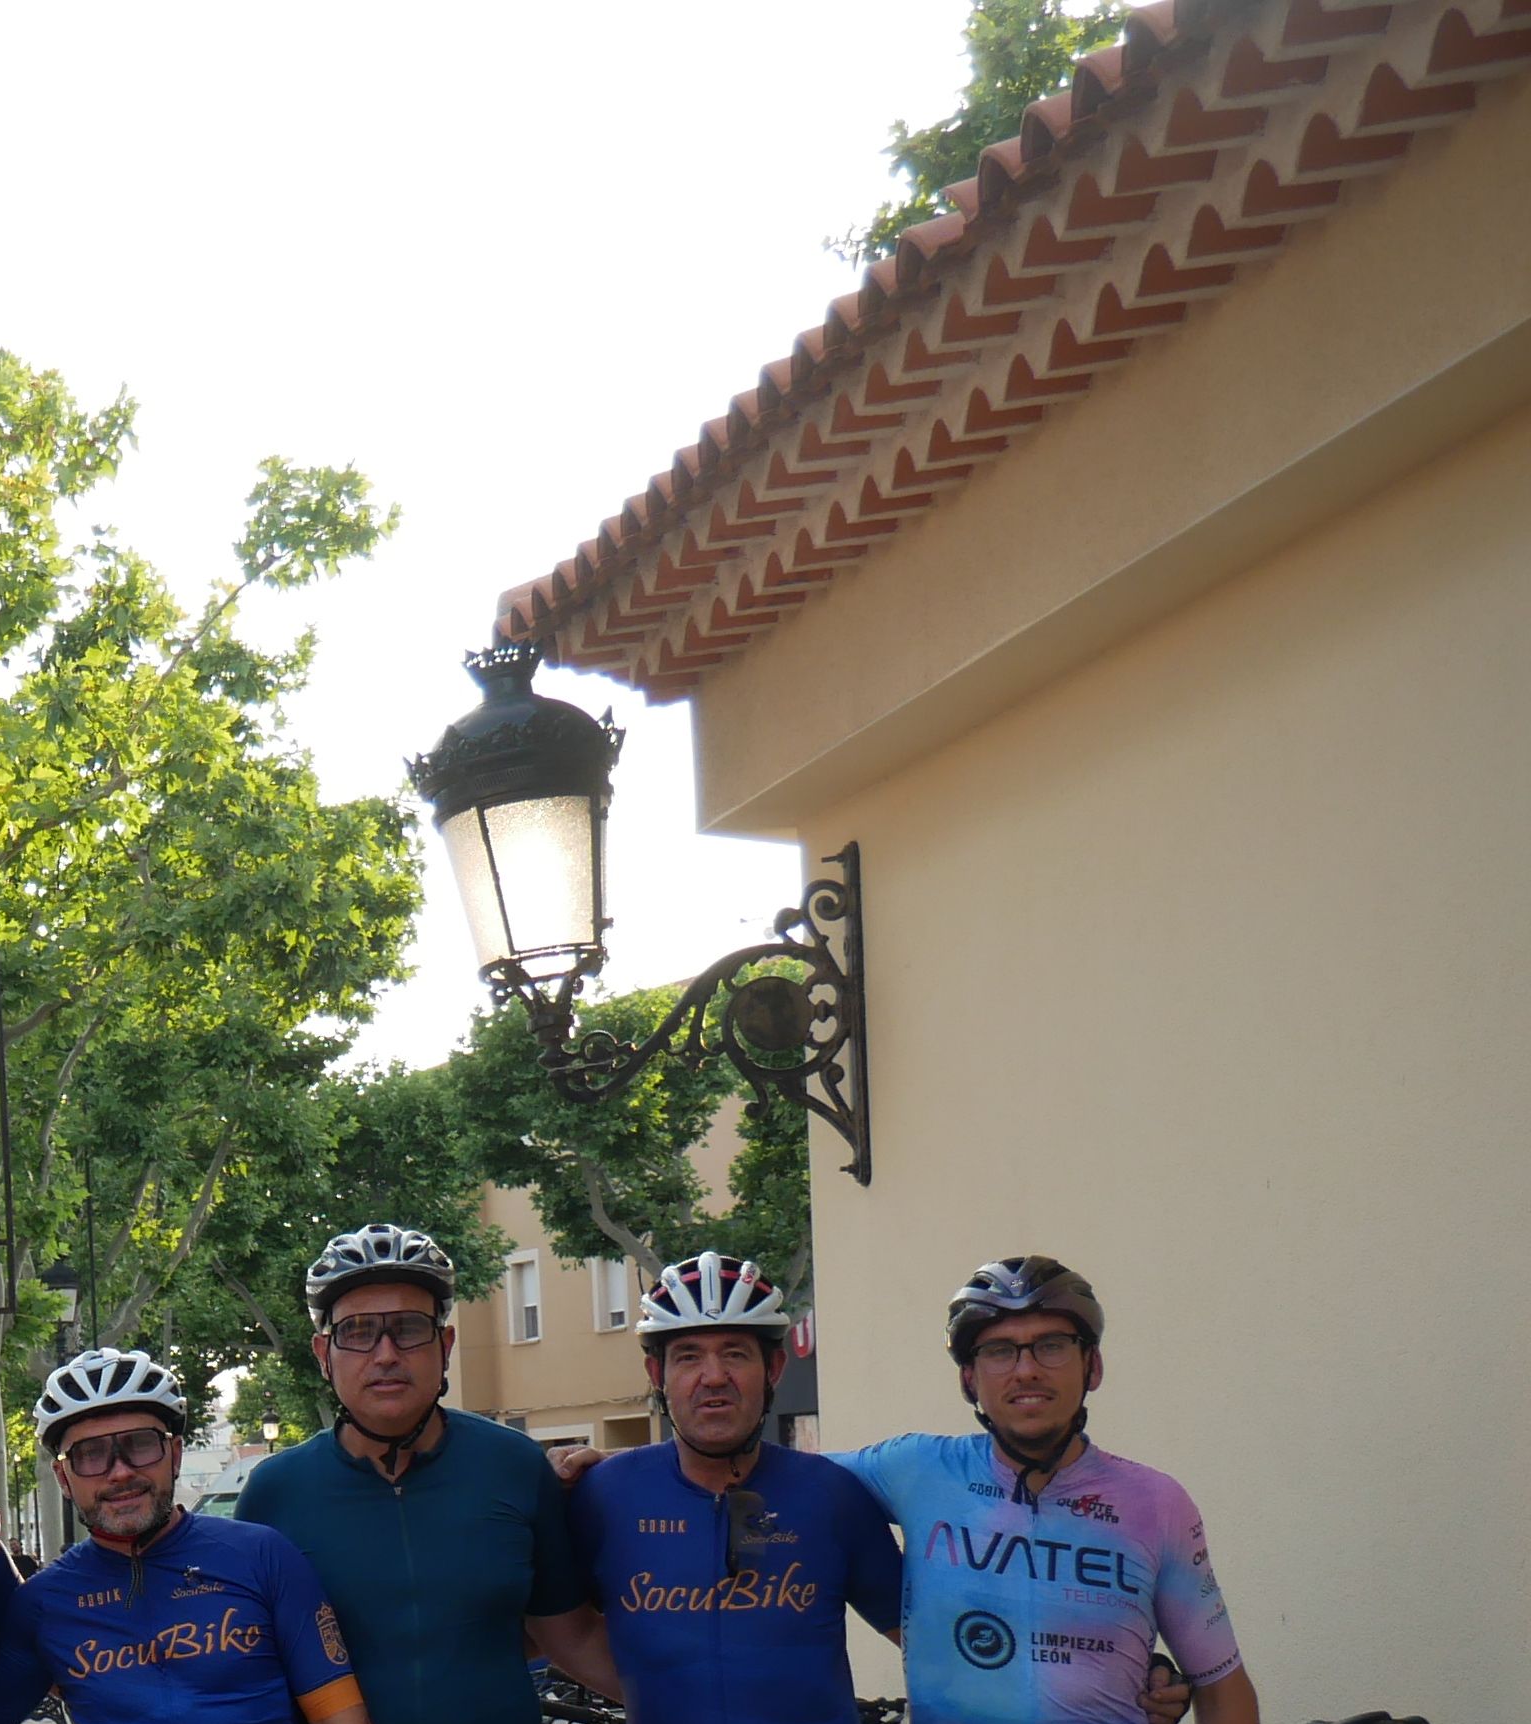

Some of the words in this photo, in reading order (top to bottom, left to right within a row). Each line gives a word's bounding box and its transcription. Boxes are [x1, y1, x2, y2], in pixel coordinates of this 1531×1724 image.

[639, 1519, 686, 1533] GOBIK
[924, 1520, 1139, 1595] AVATEL
[620, 1562, 816, 1613] SocuBike
[68, 1608, 261, 1679] SocuBike
[1031, 1632, 1115, 1653] LIMPIEZAS
[1031, 1647, 1071, 1664] LEÓN
